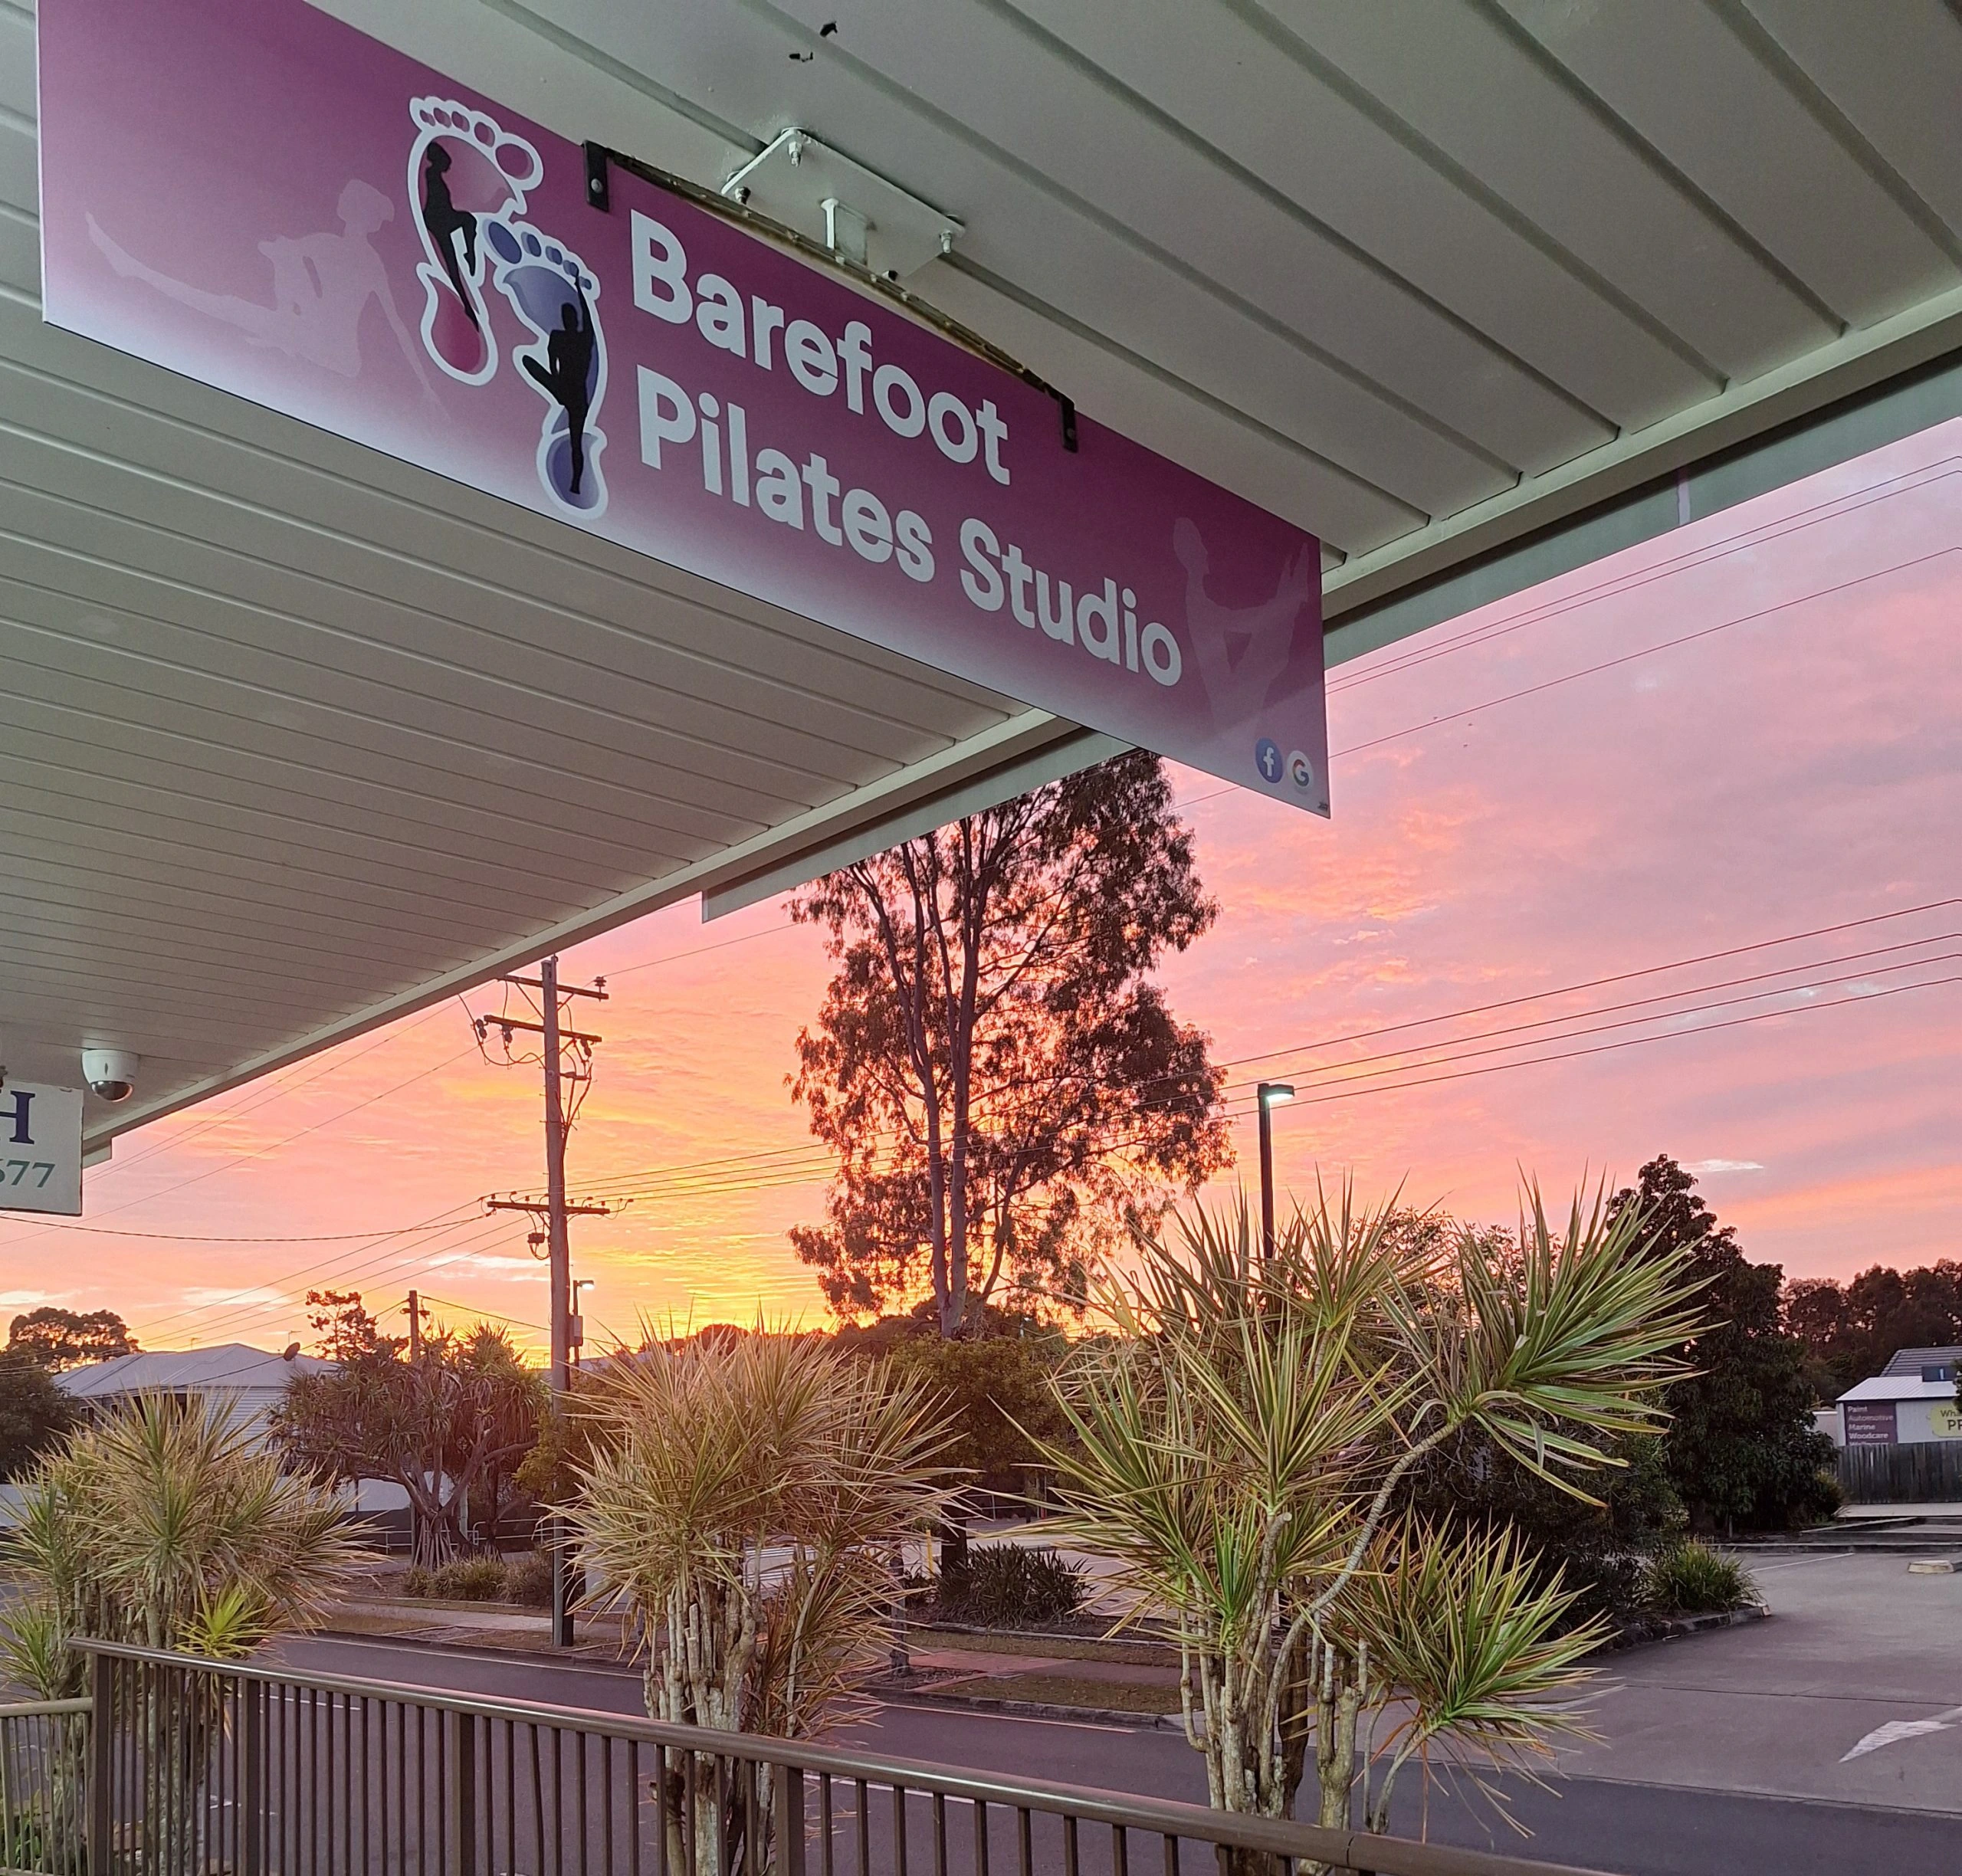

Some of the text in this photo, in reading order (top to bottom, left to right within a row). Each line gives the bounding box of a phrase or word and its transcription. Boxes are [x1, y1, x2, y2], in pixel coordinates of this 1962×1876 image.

[631, 208, 1011, 486] Barefoot
[637, 364, 1183, 687] Pilates Studio
[0, 1158, 56, 1189] 77
